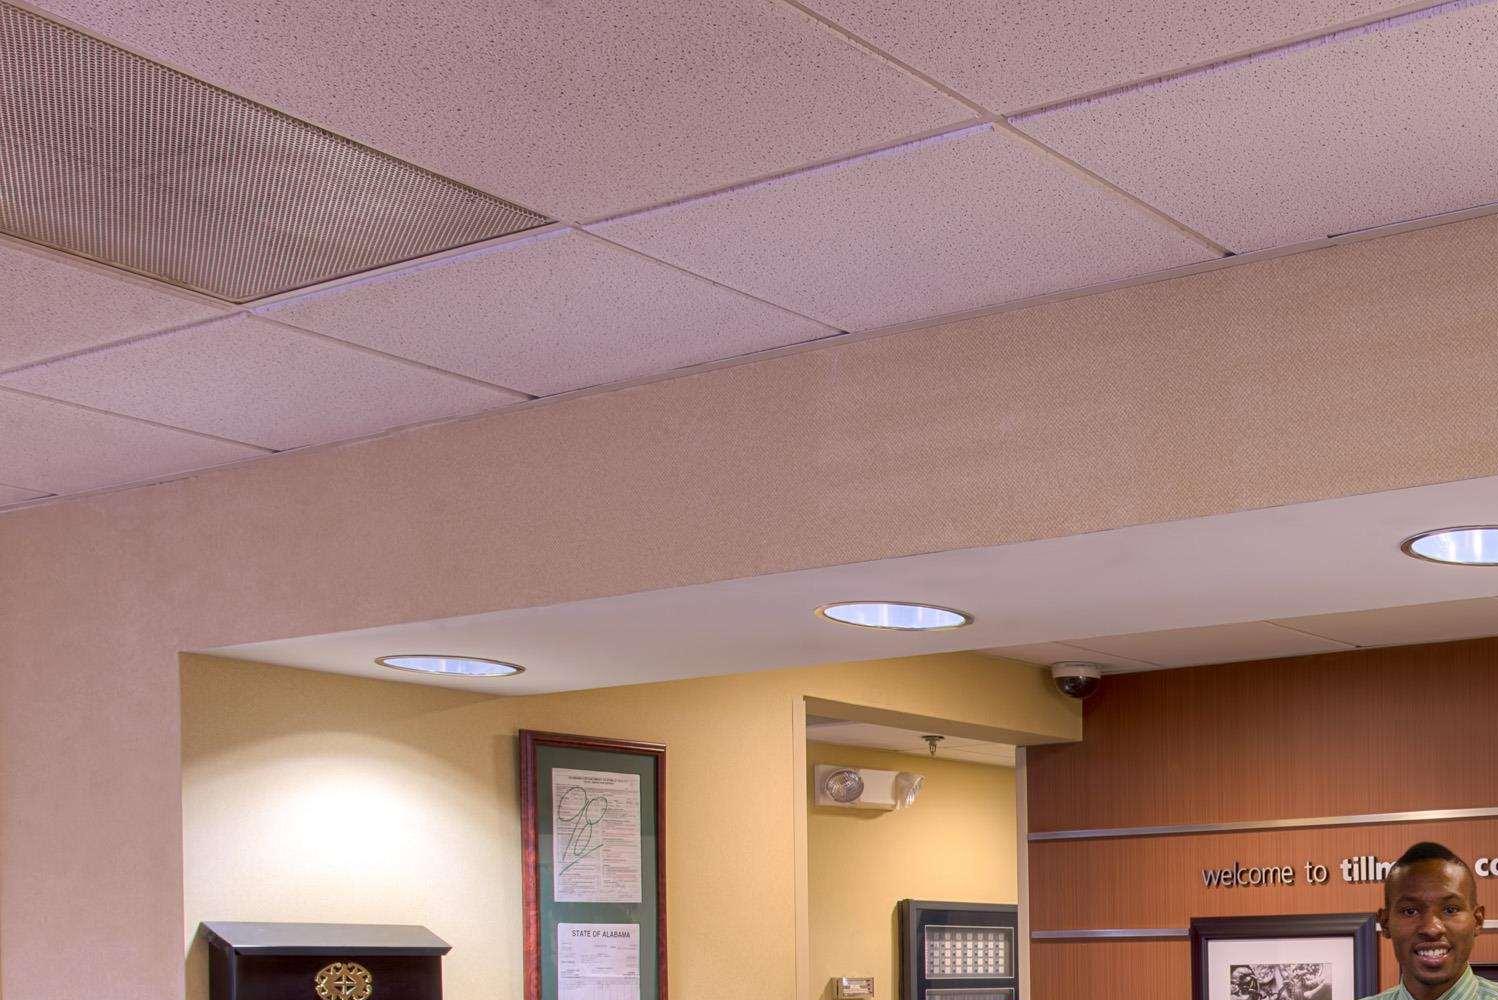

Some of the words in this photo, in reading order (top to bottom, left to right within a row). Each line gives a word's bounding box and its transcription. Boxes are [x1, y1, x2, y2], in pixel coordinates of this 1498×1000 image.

[1201, 862, 1294, 887] welcome
[1304, 862, 1328, 883] to
[1340, 856, 1398, 881] tillm
[593, 930, 601, 938] OF
[602, 930, 631, 938] ALABAMA
